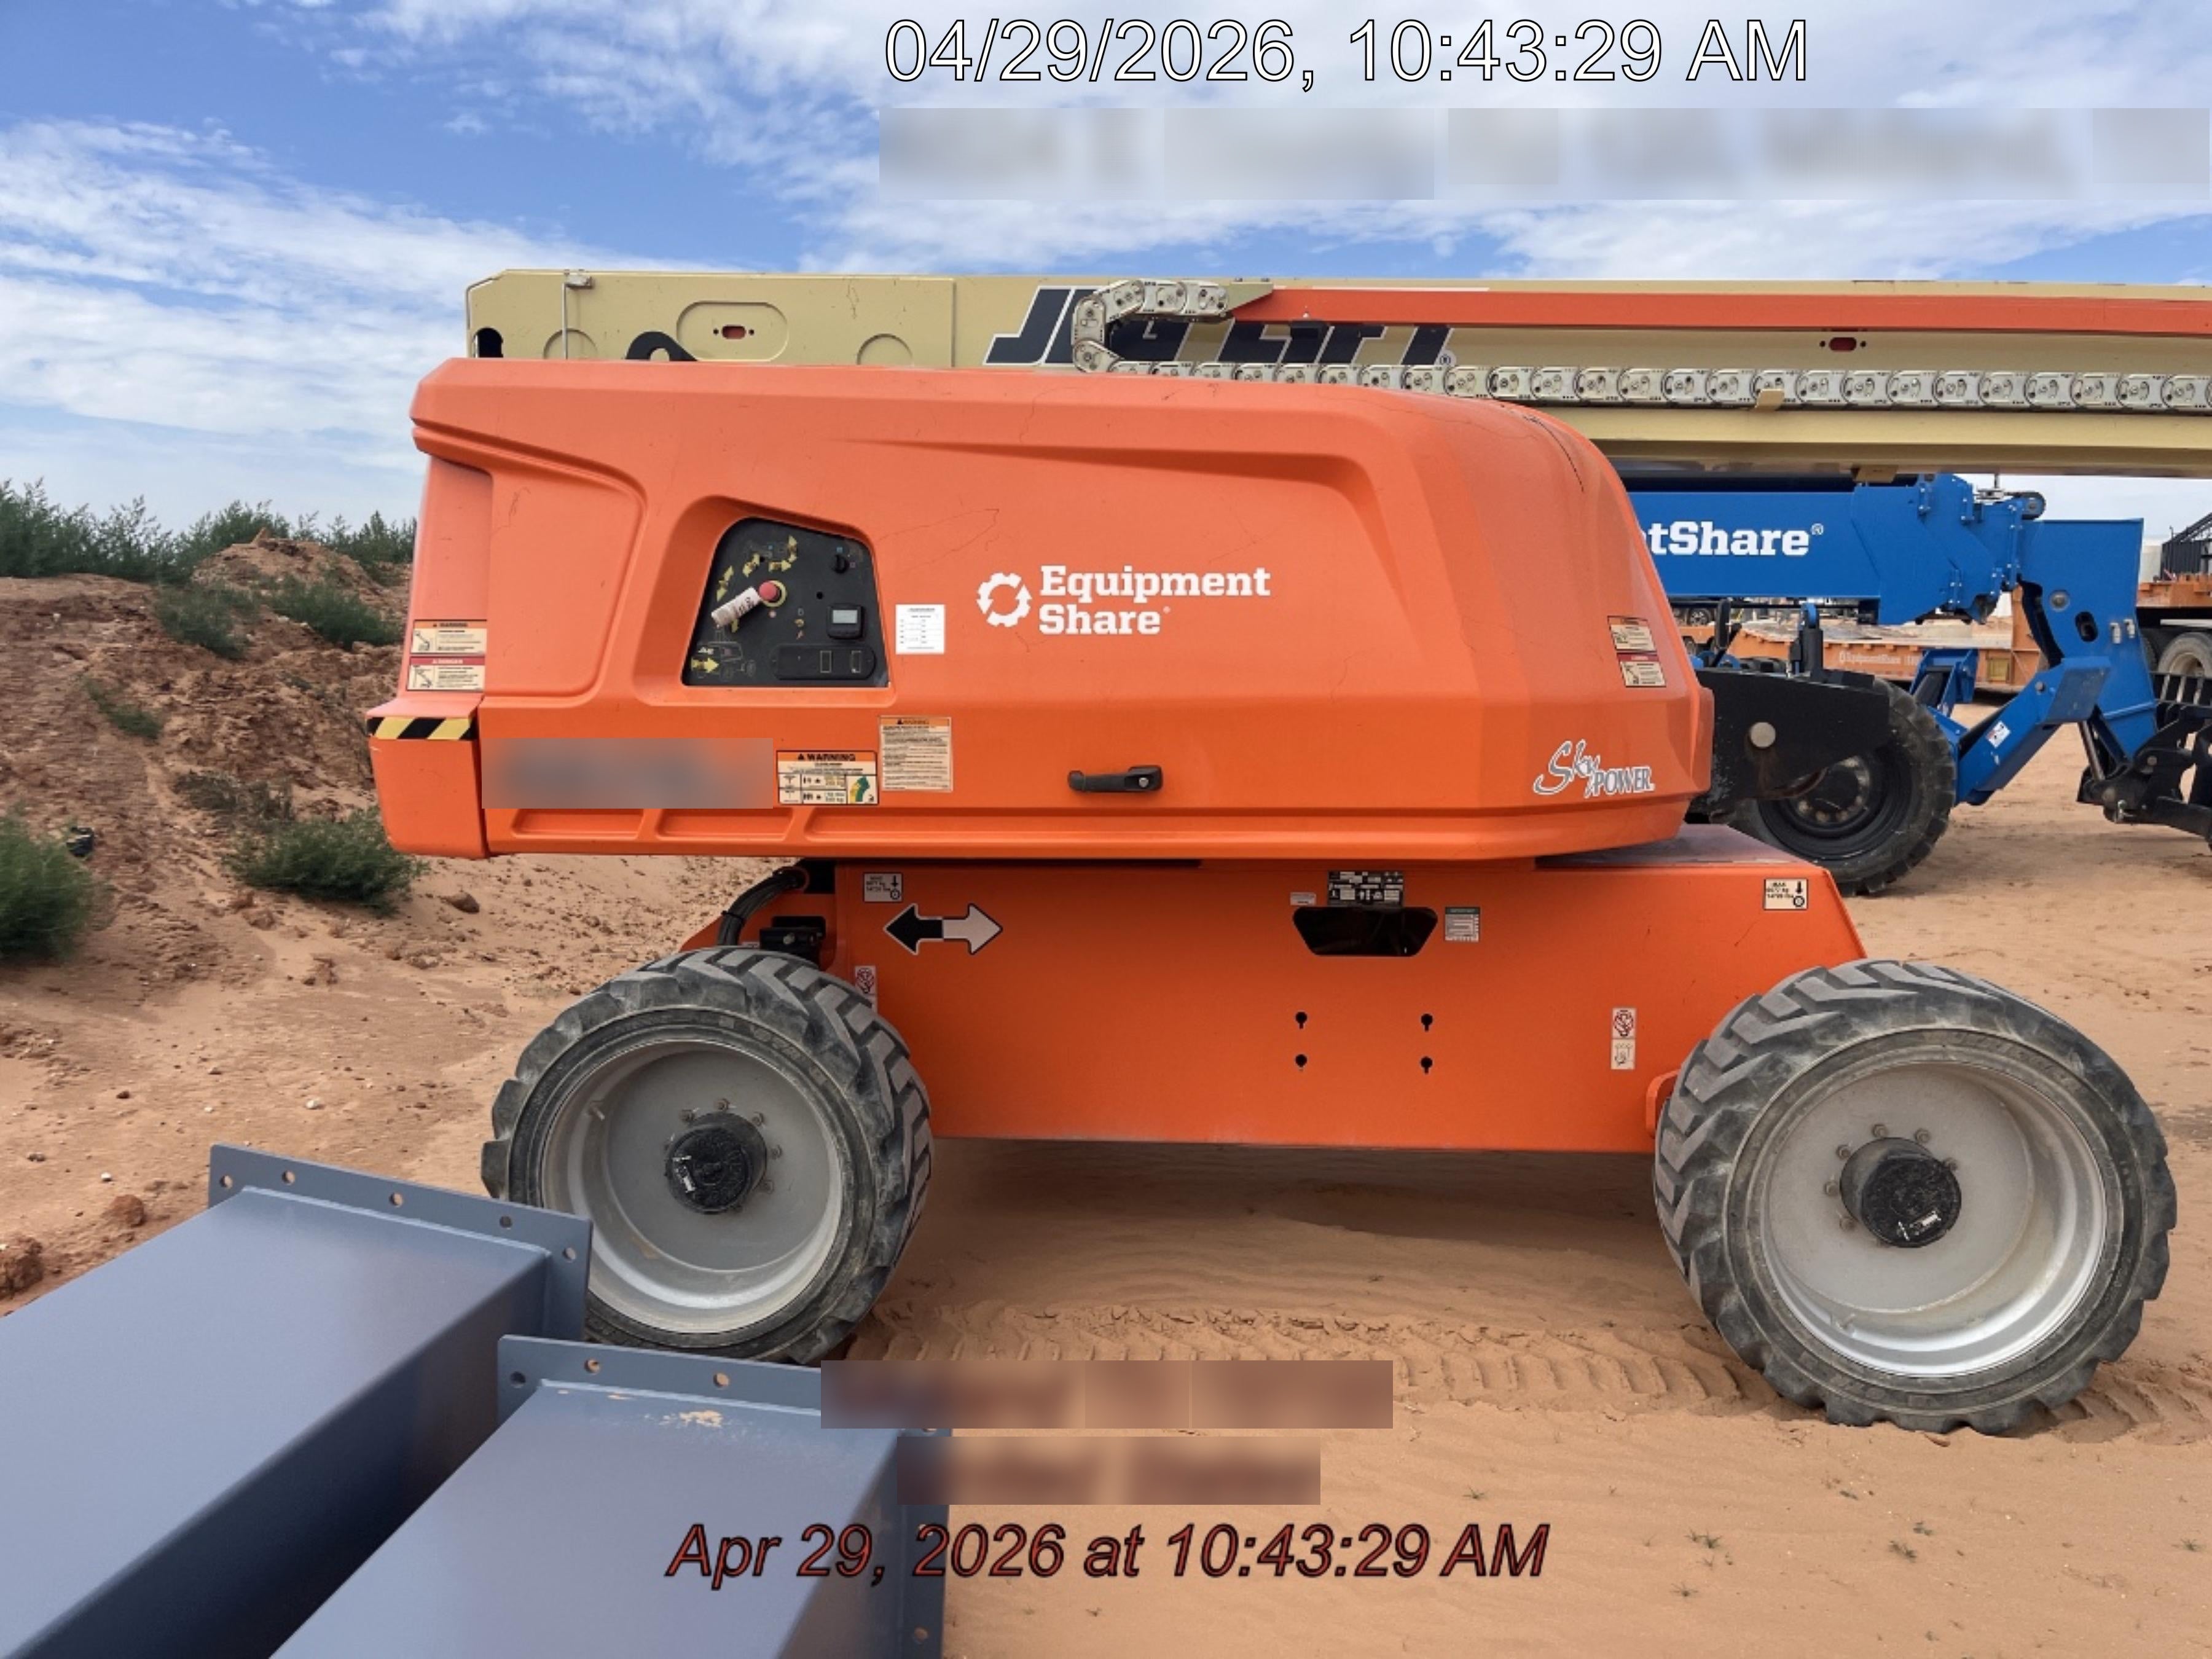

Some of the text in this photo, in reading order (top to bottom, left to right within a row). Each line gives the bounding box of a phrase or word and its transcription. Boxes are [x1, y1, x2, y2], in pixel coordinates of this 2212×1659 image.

[1642, 521, 1809, 555] tShare
[1040, 565, 1270, 603] Equipment
[1040, 604, 1160, 634] Share
